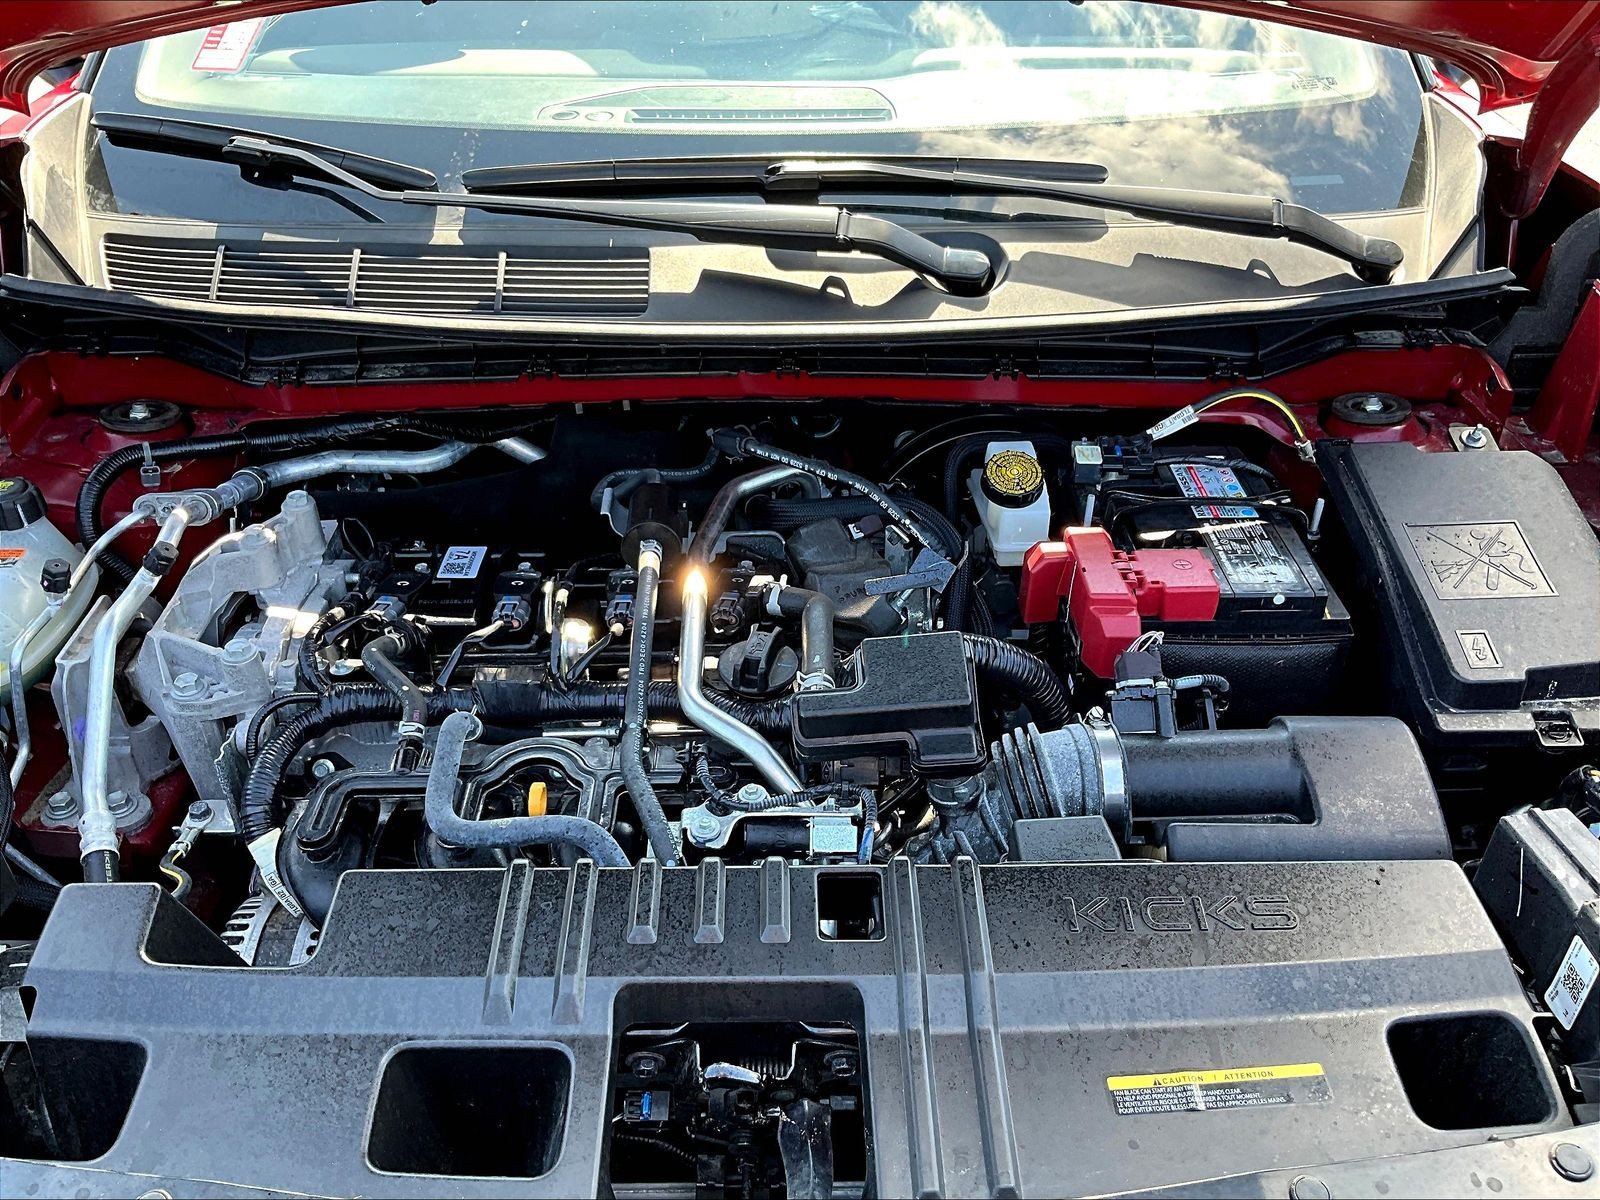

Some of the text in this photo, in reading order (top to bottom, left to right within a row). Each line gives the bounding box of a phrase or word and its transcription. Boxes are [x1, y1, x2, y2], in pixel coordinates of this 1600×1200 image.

[1063, 895, 1298, 932] KICKS
[1162, 1071, 1274, 1085] CAUTION ATTENTION
[1124, 1088, 1140, 1096] BLADE
[1152, 1092, 1178, 1100] PERSONAL
[1124, 1099, 1160, 1107] VENTILATEUR
[1152, 1104, 1171, 1112] TOUTE
[1225, 1098, 1258, 1106] APPROCHER
